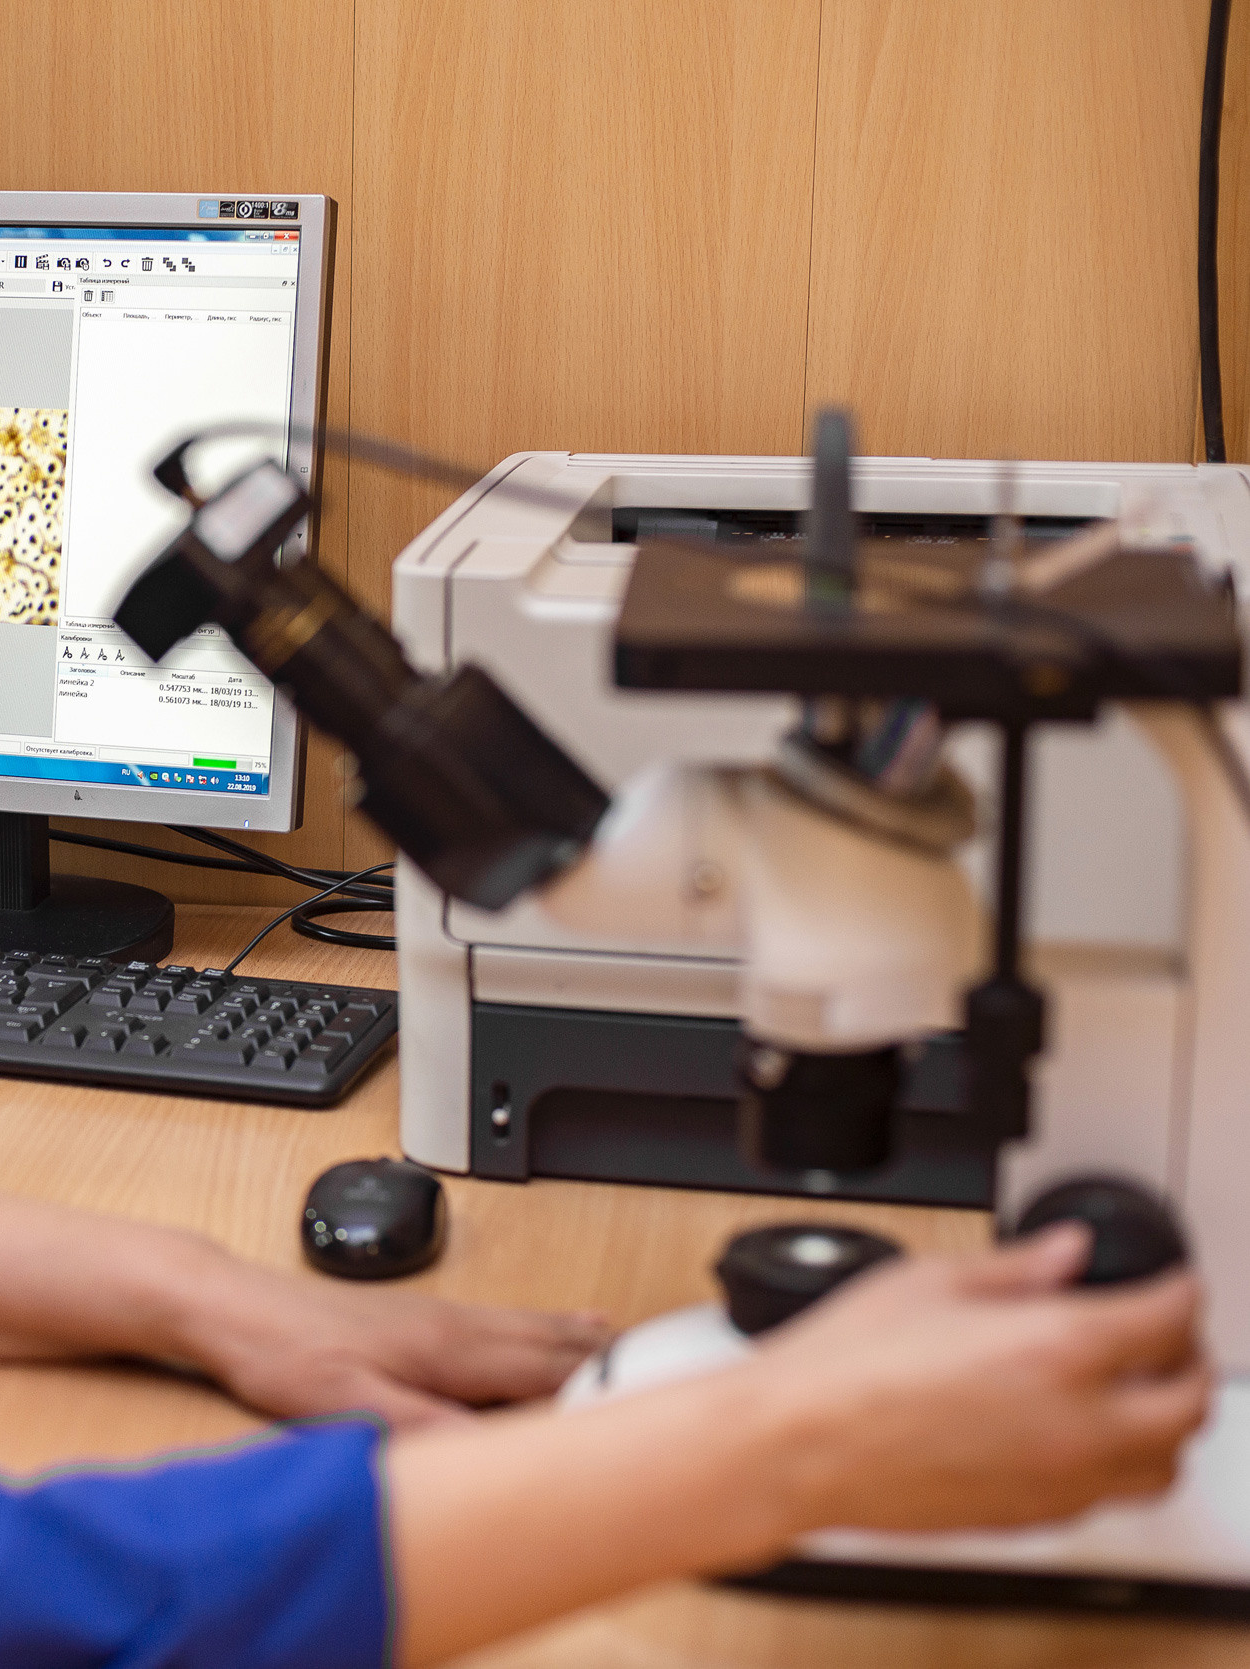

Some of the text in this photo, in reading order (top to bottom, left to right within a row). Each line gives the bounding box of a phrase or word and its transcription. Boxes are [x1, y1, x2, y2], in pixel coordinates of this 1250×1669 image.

[159, 684, 191, 693] 0.547753
[211, 687, 242, 697] 18/03/19
[159, 696, 190, 705] 0.561073
[210, 699, 241, 708] 18/03/19
[26, 745, 94, 757] Отсутствует калибровка.
[227, 783, 256, 791] 22.08.2019
